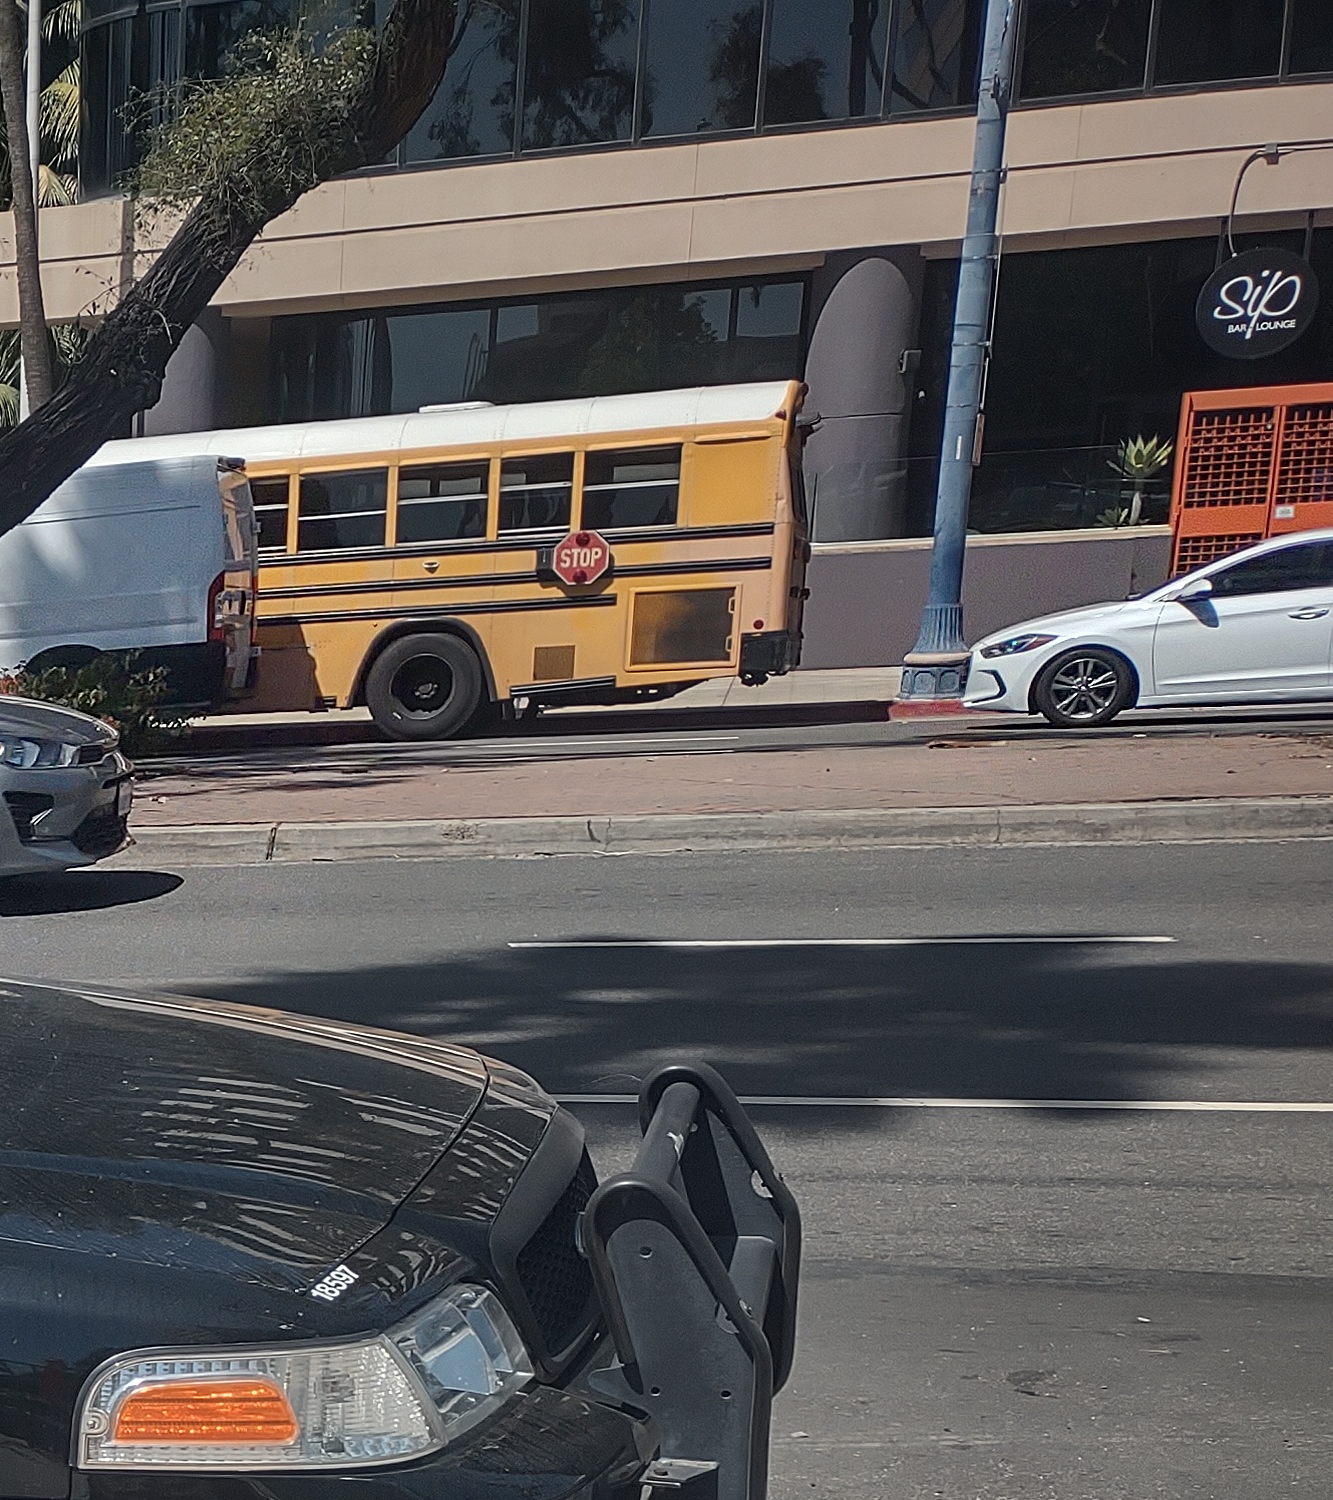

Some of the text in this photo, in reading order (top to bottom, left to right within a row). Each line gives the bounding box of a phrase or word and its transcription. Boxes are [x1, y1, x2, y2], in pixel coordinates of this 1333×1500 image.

[1227, 319, 1296, 333] BAR LOUNGE
[560, 547, 603, 568] STOP
[311, 1264, 359, 1301] 18597
